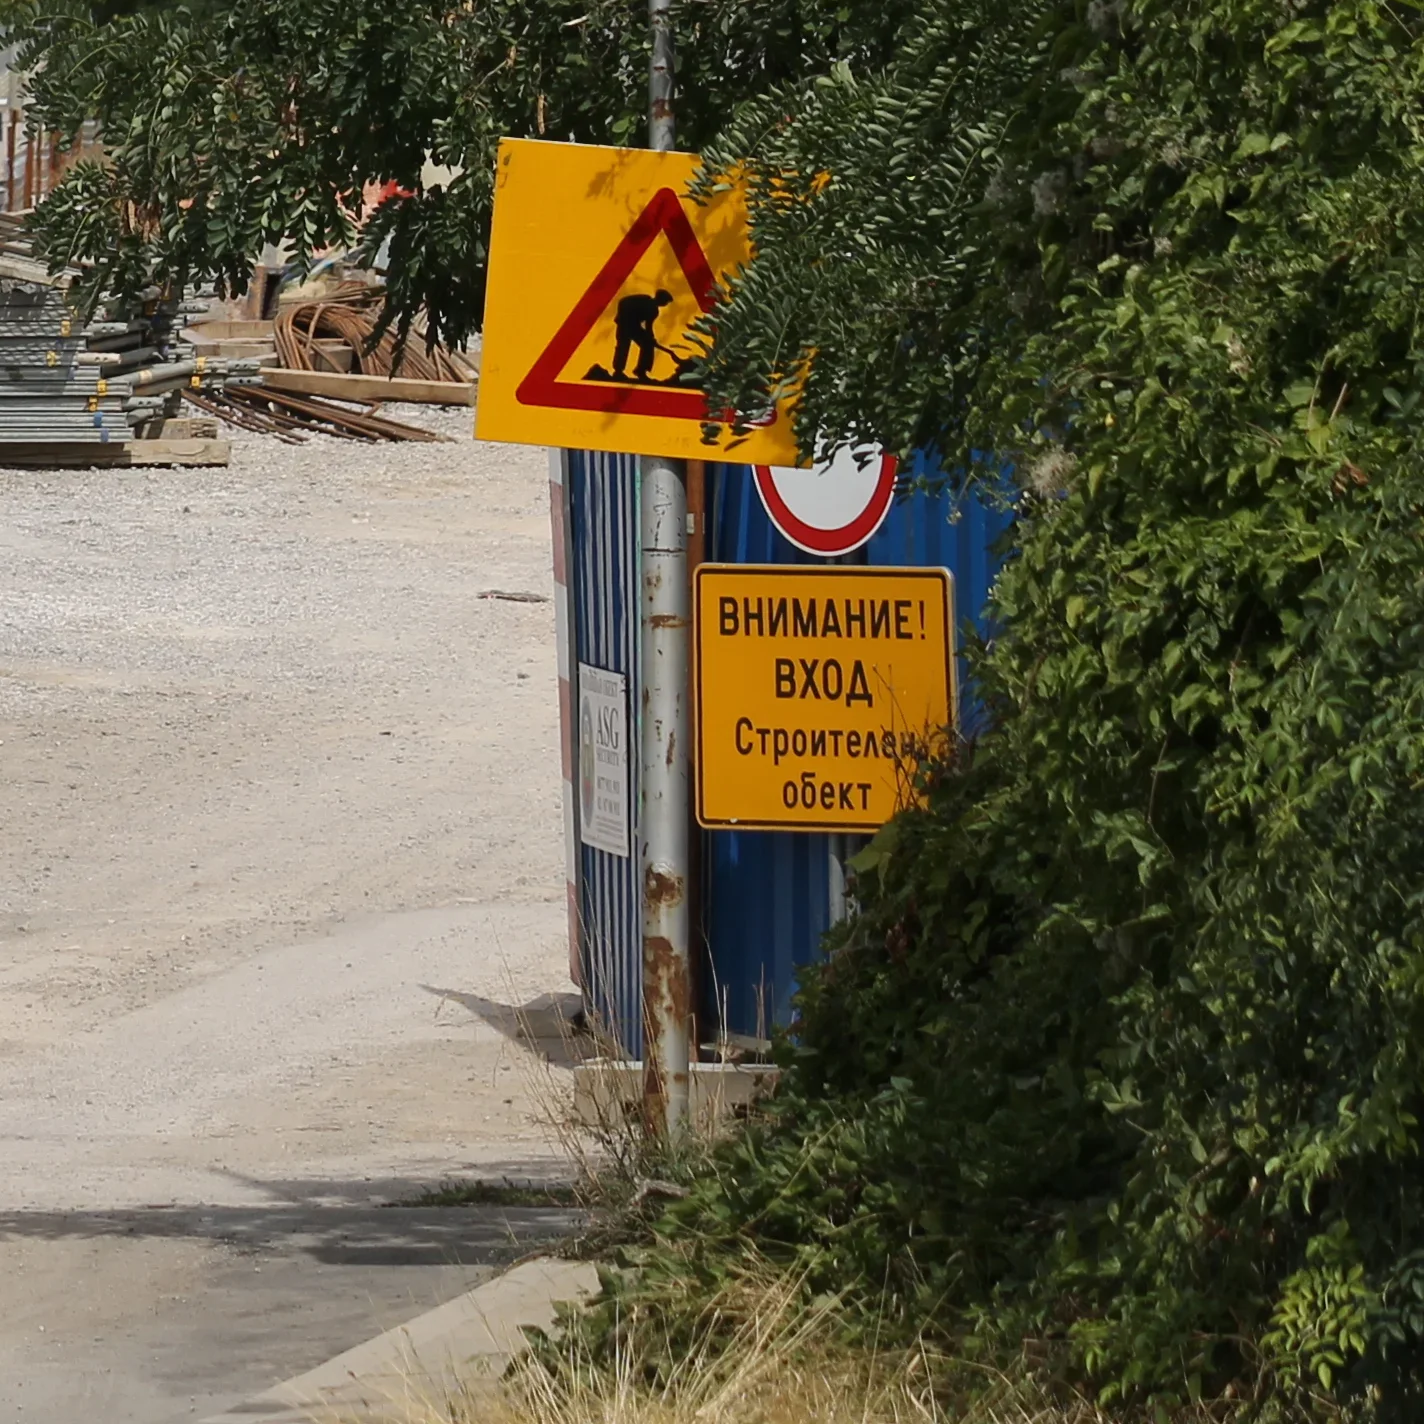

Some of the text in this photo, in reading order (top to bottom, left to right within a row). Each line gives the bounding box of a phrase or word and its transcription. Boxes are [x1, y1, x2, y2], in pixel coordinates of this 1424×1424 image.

[719, 596, 926, 640] ВНИМАНИЕ!
[775, 658, 873, 708] ВХОД
[596, 706, 619, 750] ASG
[735, 716, 915, 766] Строителен
[783, 772, 872, 810] обект
